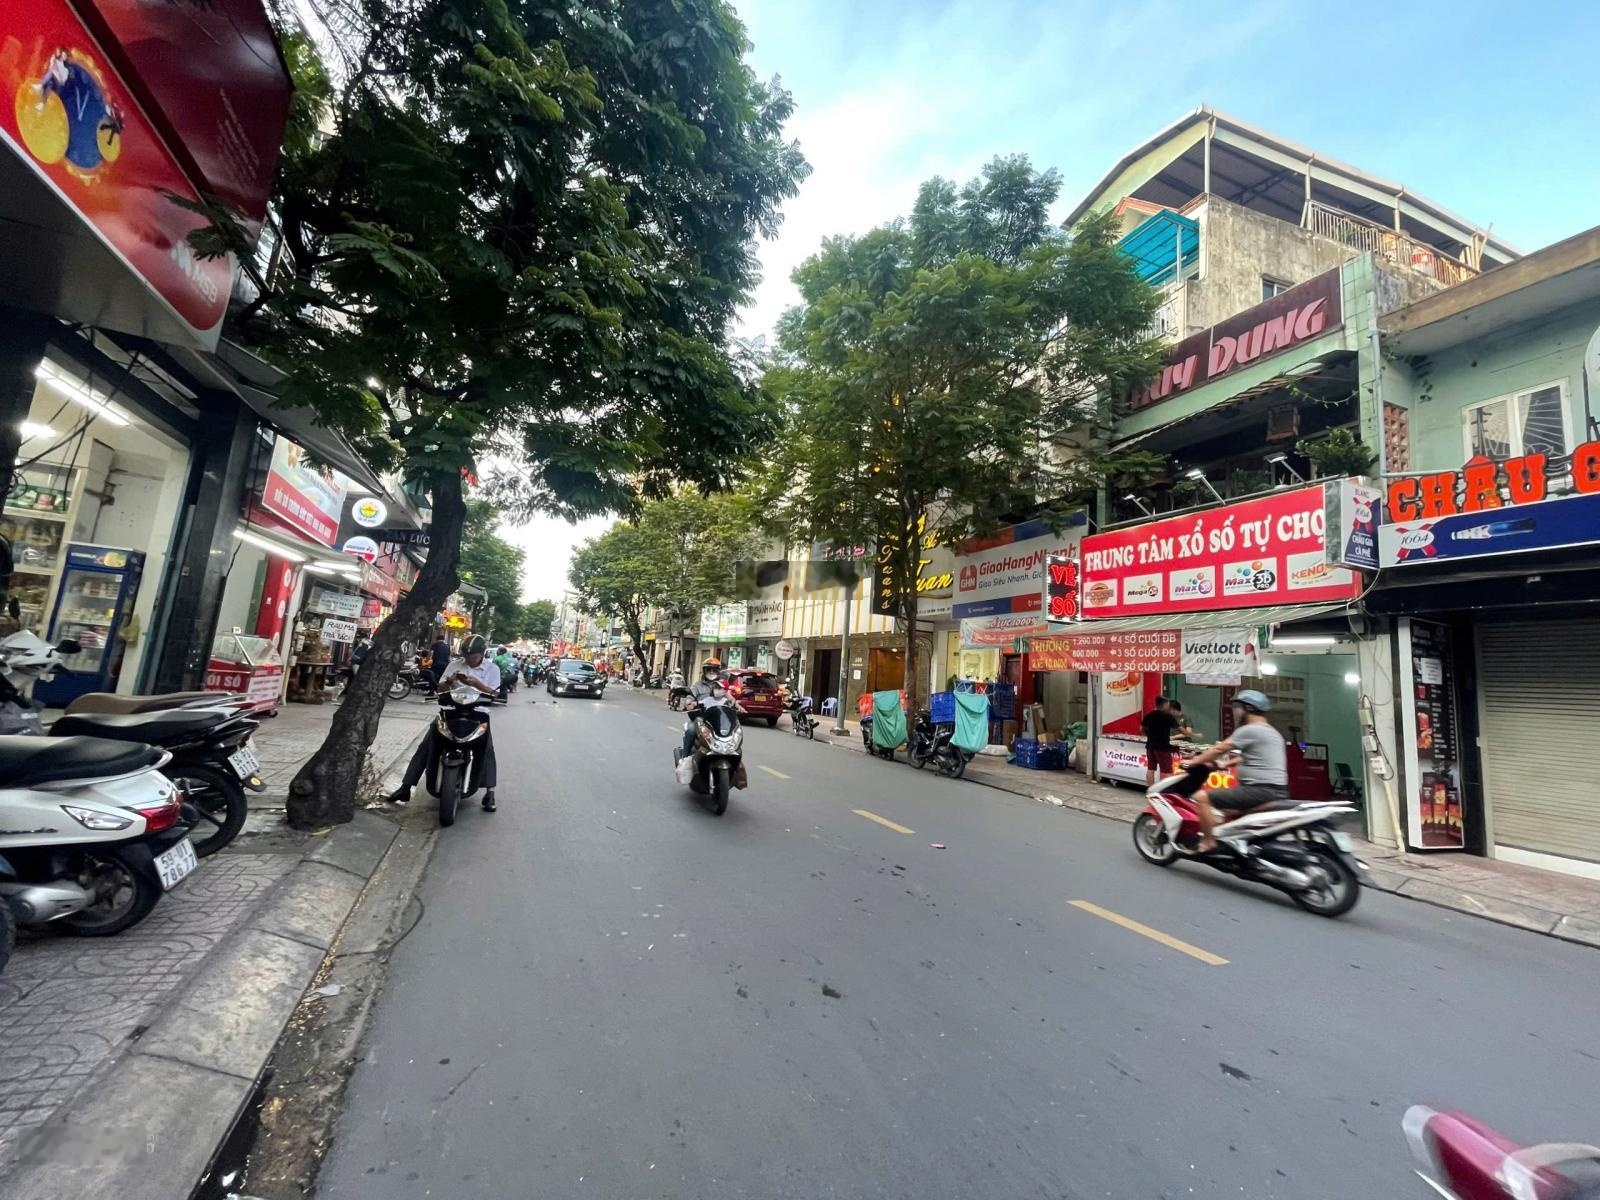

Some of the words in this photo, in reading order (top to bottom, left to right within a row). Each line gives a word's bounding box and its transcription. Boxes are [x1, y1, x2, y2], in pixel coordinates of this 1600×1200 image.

[1208, 296, 1327, 378] DUNG
[1387, 452, 1548, 523] CHÂU
[1084, 544, 1135, 572] TRUNG
[1138, 535, 1175, 565] TÂM
[1178, 520, 1204, 559] XỔ
[1210, 515, 1236, 552] SỐ
[1240, 515, 1272, 551] TỰ
[1051, 562, 1077, 587] VÉ
[960, 577, 976, 588] GHN
[1225, 577, 1251, 586] Max
[1051, 590, 1077, 617] SỐ
[1124, 633, 1137, 644] SỐ
[1138, 632, 1160, 644] CUỐI
[1124, 646, 1137, 657] SỐ
[1138, 646, 1160, 657] CUỐI
[1185, 642, 1241, 655] Vietlott
[1124, 660, 1137, 671] SỐ
[1138, 660, 1160, 671] CUỐI
